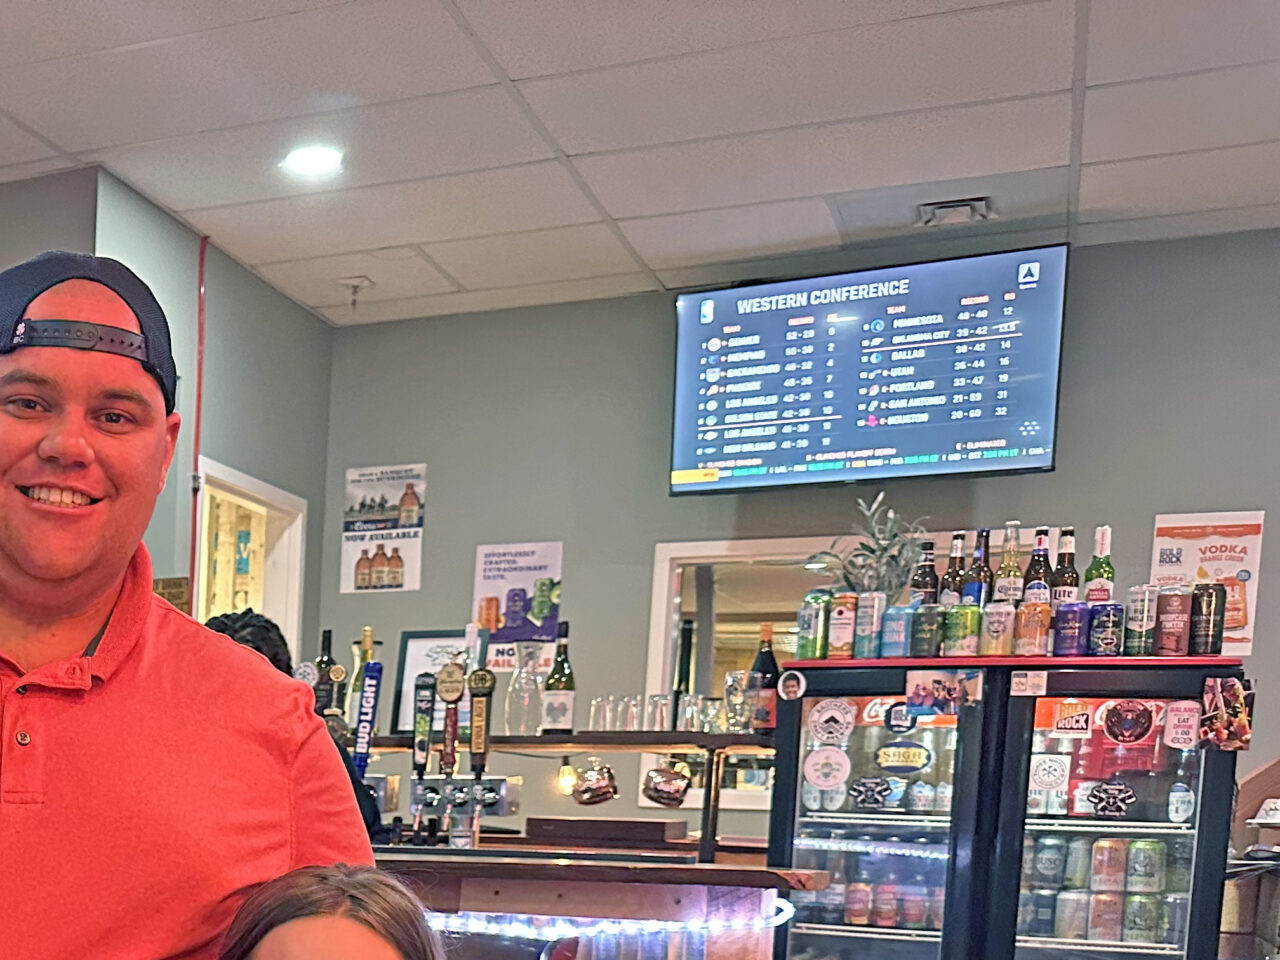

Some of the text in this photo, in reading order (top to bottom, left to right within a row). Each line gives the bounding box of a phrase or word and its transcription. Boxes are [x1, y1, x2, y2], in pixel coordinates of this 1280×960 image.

[736, 279, 910, 315] WESTERN CONFERENCE
[344, 530, 419, 542] NOW AVAILABLE
[1198, 544, 1248, 556] VODKA
[1053, 589, 1073, 600] Lite
[356, 677, 377, 753] BUD LIGHT
[1057, 714, 1089, 729] ROCK
